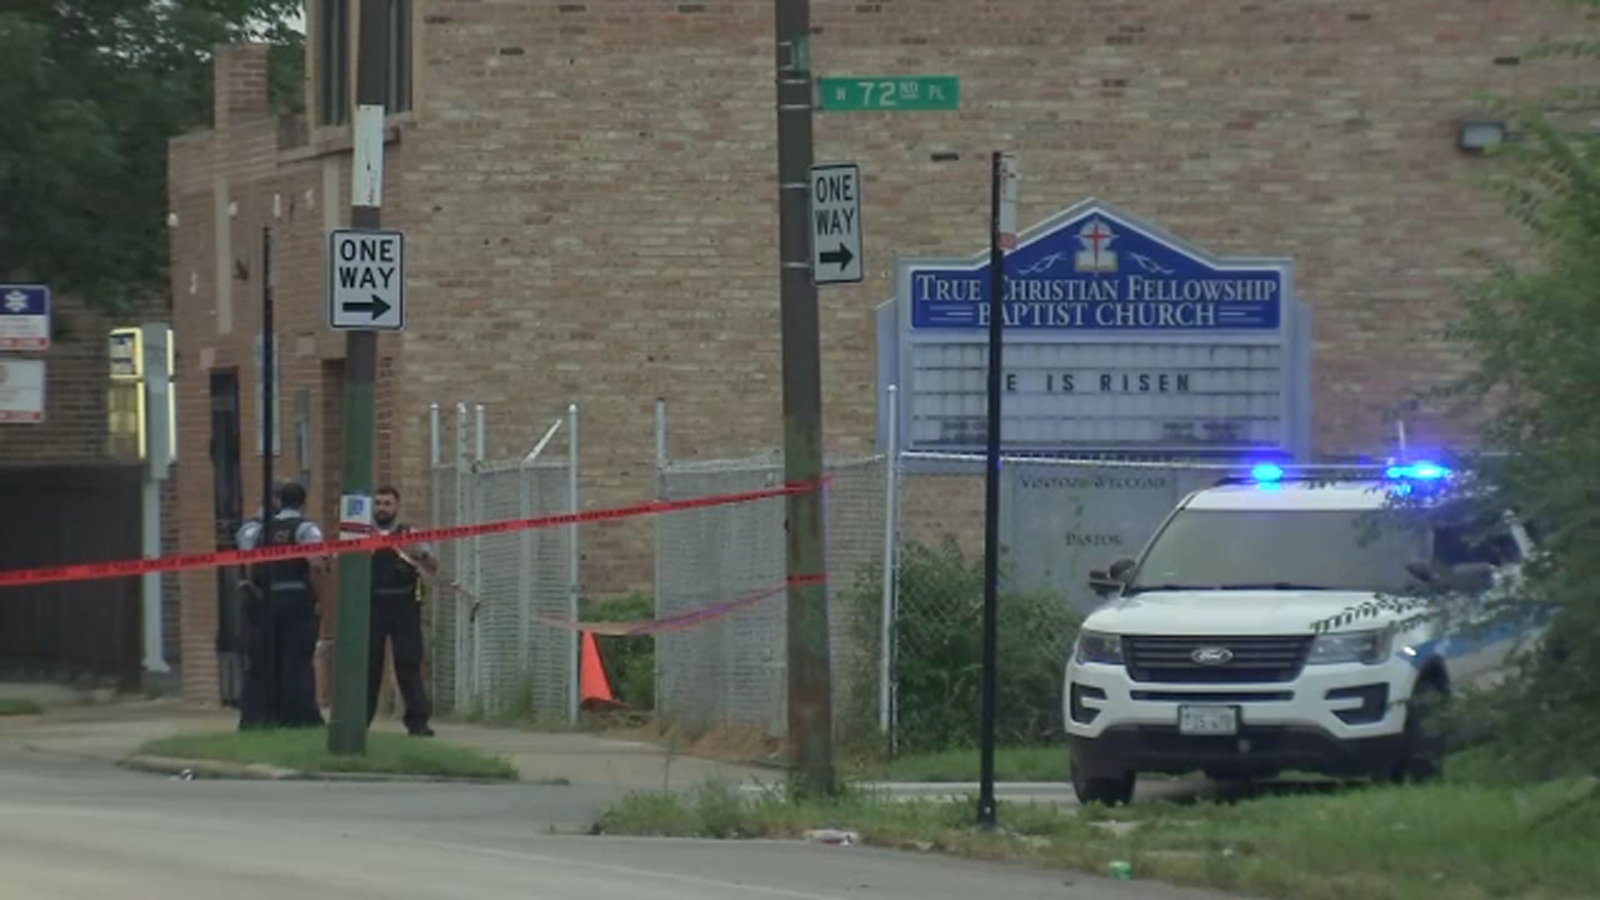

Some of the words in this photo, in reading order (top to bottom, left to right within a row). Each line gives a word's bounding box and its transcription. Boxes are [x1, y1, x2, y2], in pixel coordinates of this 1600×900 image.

[928, 84, 946, 101] PL
[815, 174, 853, 203] ONE
[815, 207, 855, 236] WAY
[340, 239, 394, 262] ONE
[339, 266, 396, 289] WAY
[916, 274, 982, 301] TRUE
[1127, 274, 1277, 301] FELLOWSHIP
[1095, 302, 1215, 326] CHURCH
[1047, 374, 1074, 391] IS
[1100, 374, 1189, 391] RISEN
